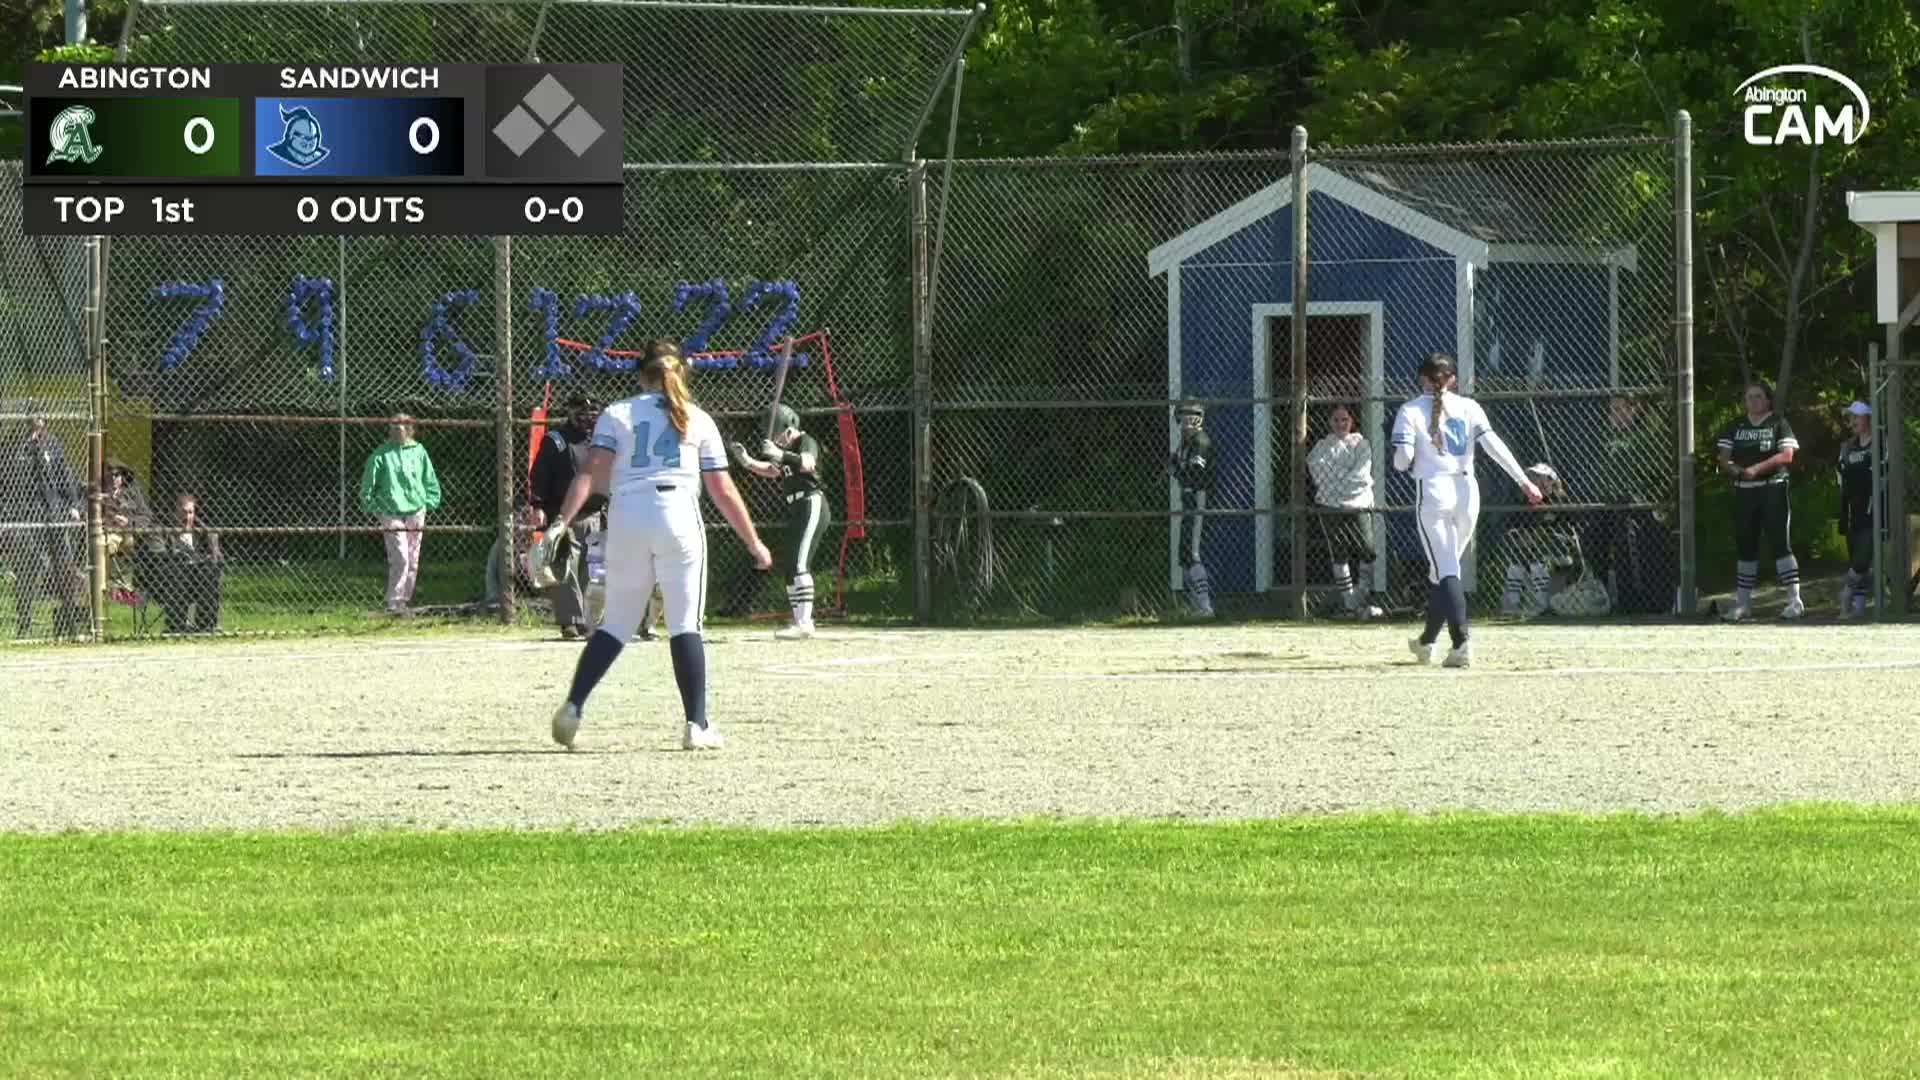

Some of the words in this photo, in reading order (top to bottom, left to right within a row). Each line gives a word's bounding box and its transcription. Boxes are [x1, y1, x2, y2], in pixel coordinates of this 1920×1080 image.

[152, 278, 225, 369] 7
[289, 274, 334, 383] 9
[420, 289, 480, 393] 6
